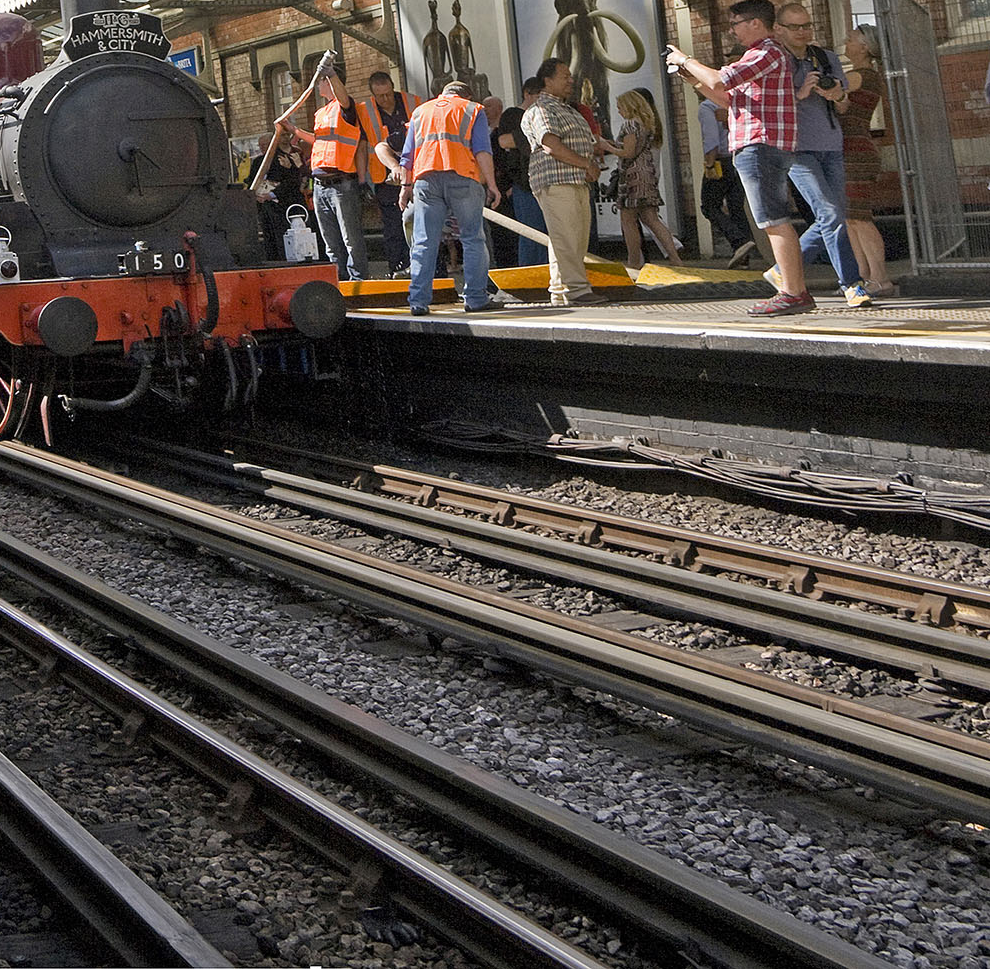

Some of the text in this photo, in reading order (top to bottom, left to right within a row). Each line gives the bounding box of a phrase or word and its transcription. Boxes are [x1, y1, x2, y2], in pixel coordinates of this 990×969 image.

[71, 28, 164, 47] HAMMERSMITH
[98, 40, 137, 51] & CITY
